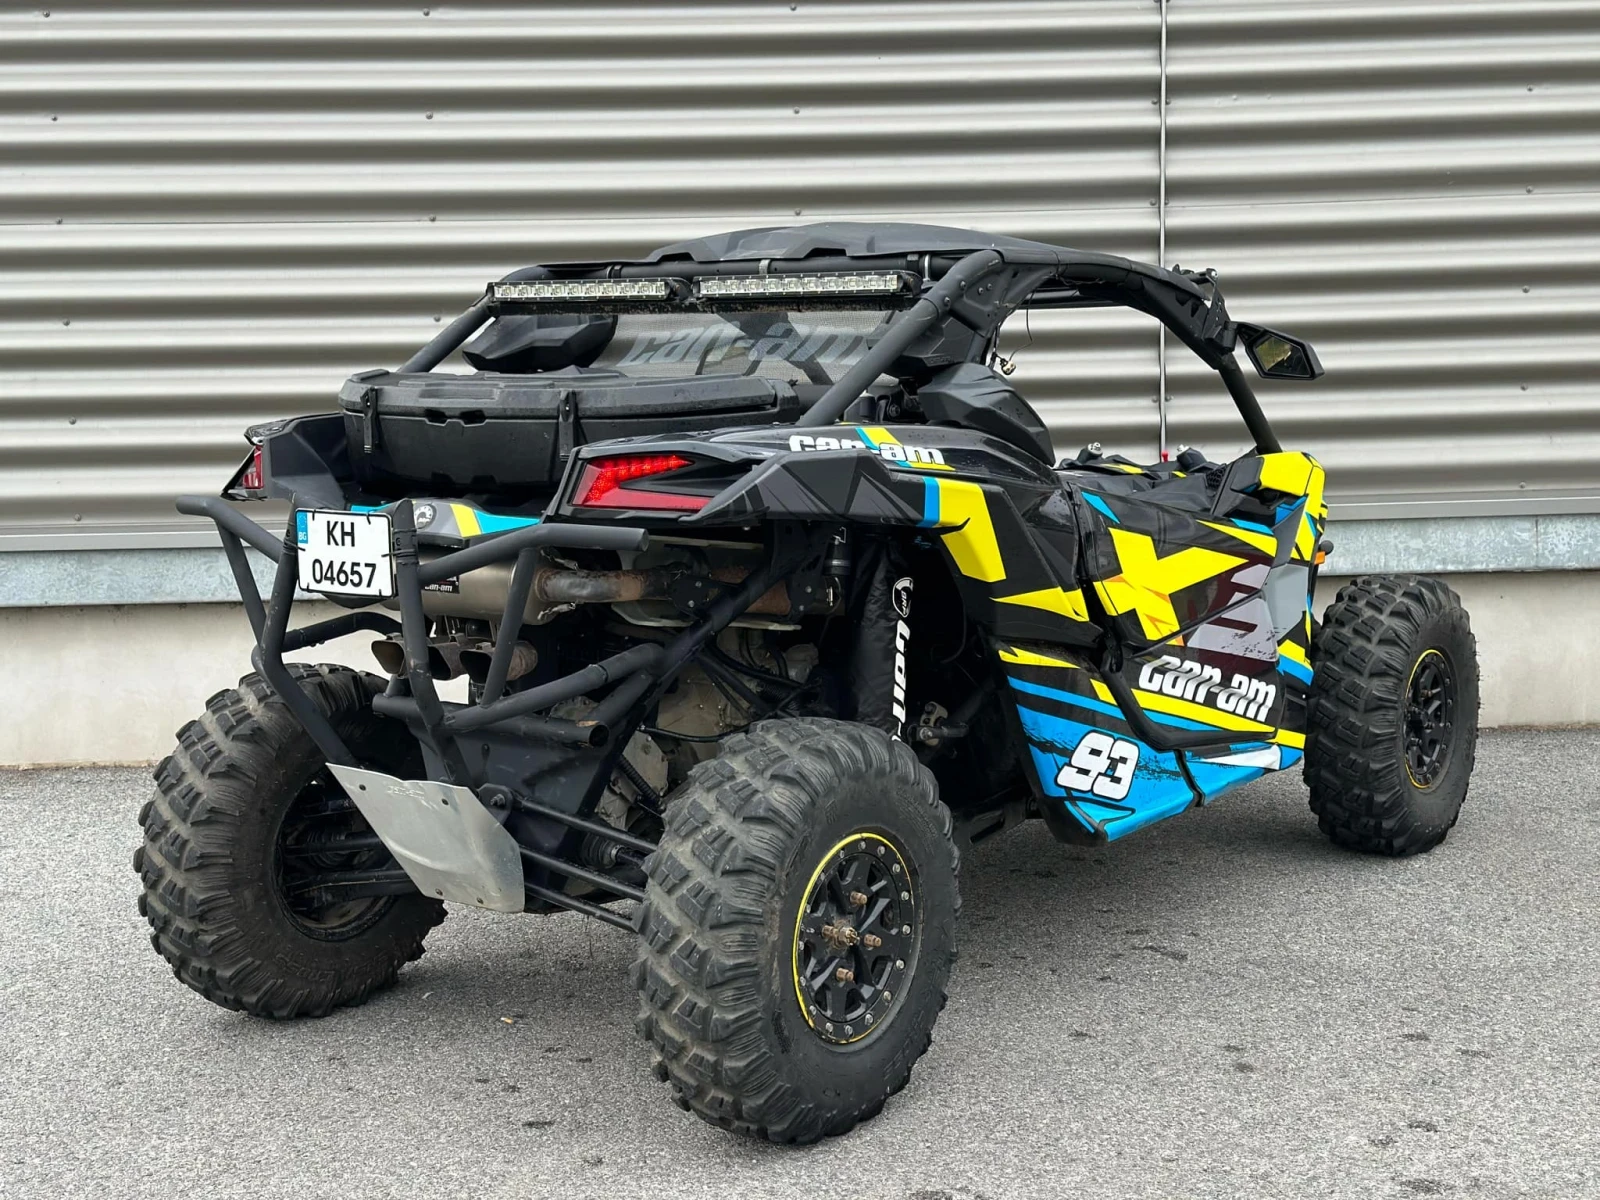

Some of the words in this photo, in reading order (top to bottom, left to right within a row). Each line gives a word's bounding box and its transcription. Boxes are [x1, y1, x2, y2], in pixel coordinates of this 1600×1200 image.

[615, 322, 868, 366] can-am
[298, 531, 307, 541] BG
[326, 520, 356, 548] KH
[312, 558, 377, 588] 04657
[1138, 655, 1277, 722] can-am
[1057, 731, 1139, 800] 93
